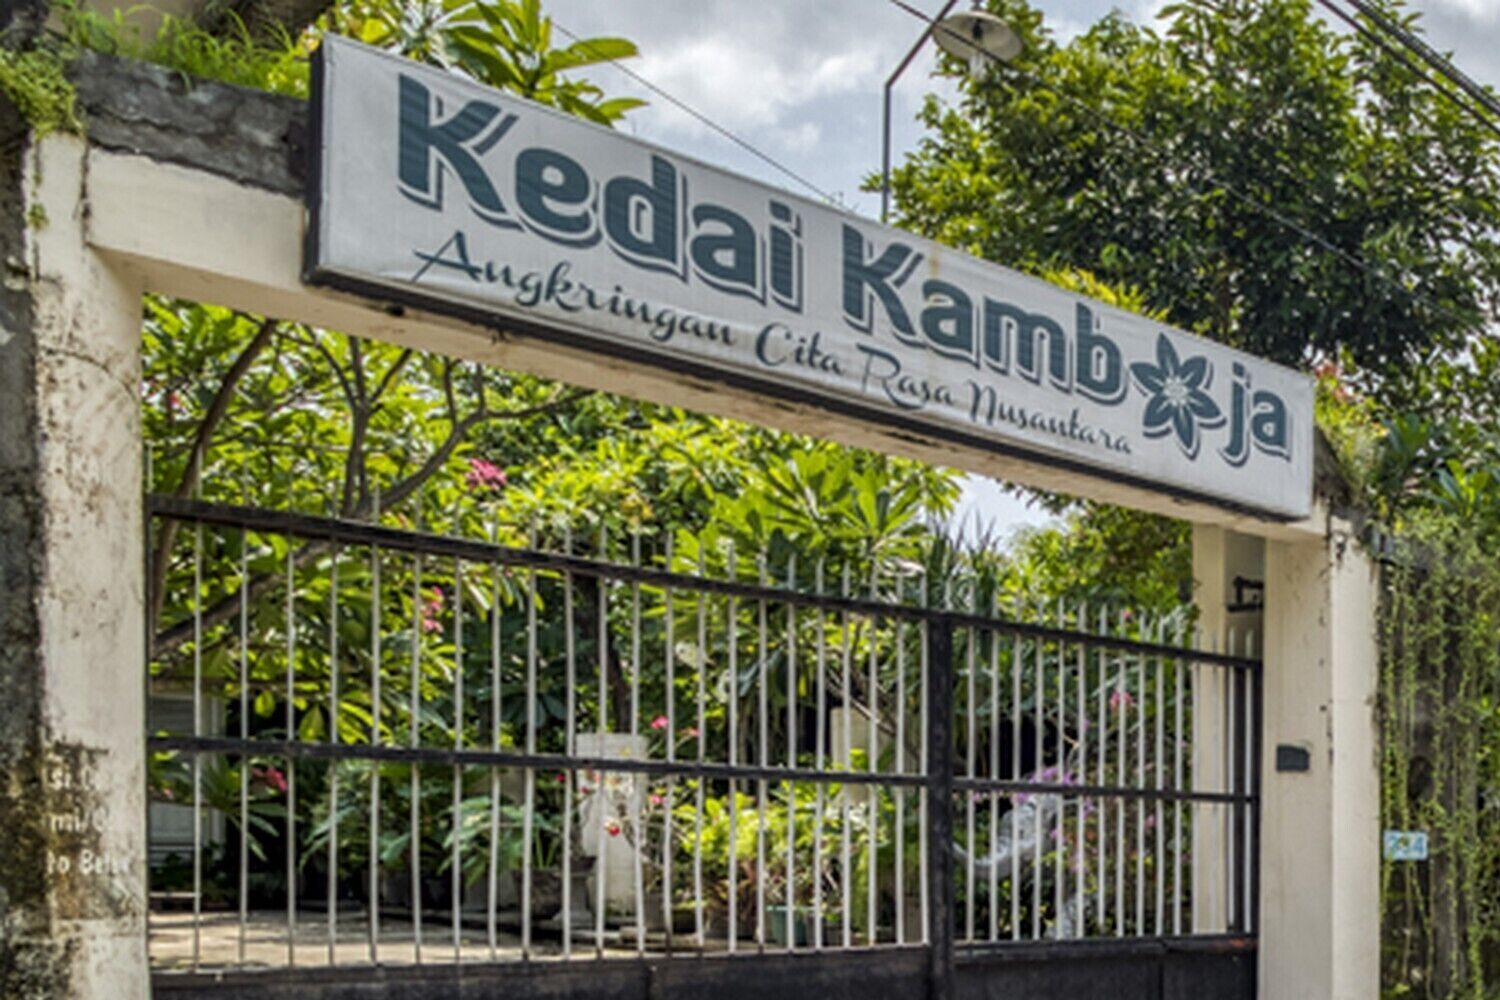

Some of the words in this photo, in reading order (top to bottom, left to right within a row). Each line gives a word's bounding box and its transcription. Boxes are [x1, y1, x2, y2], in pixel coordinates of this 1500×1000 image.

[398, 72, 802, 313] Kedai
[411, 230, 736, 346] Angkringan
[754, 321, 846, 376] Cita
[856, 344, 955, 410] Rasa
[964, 379, 1132, 456] Nusantara
